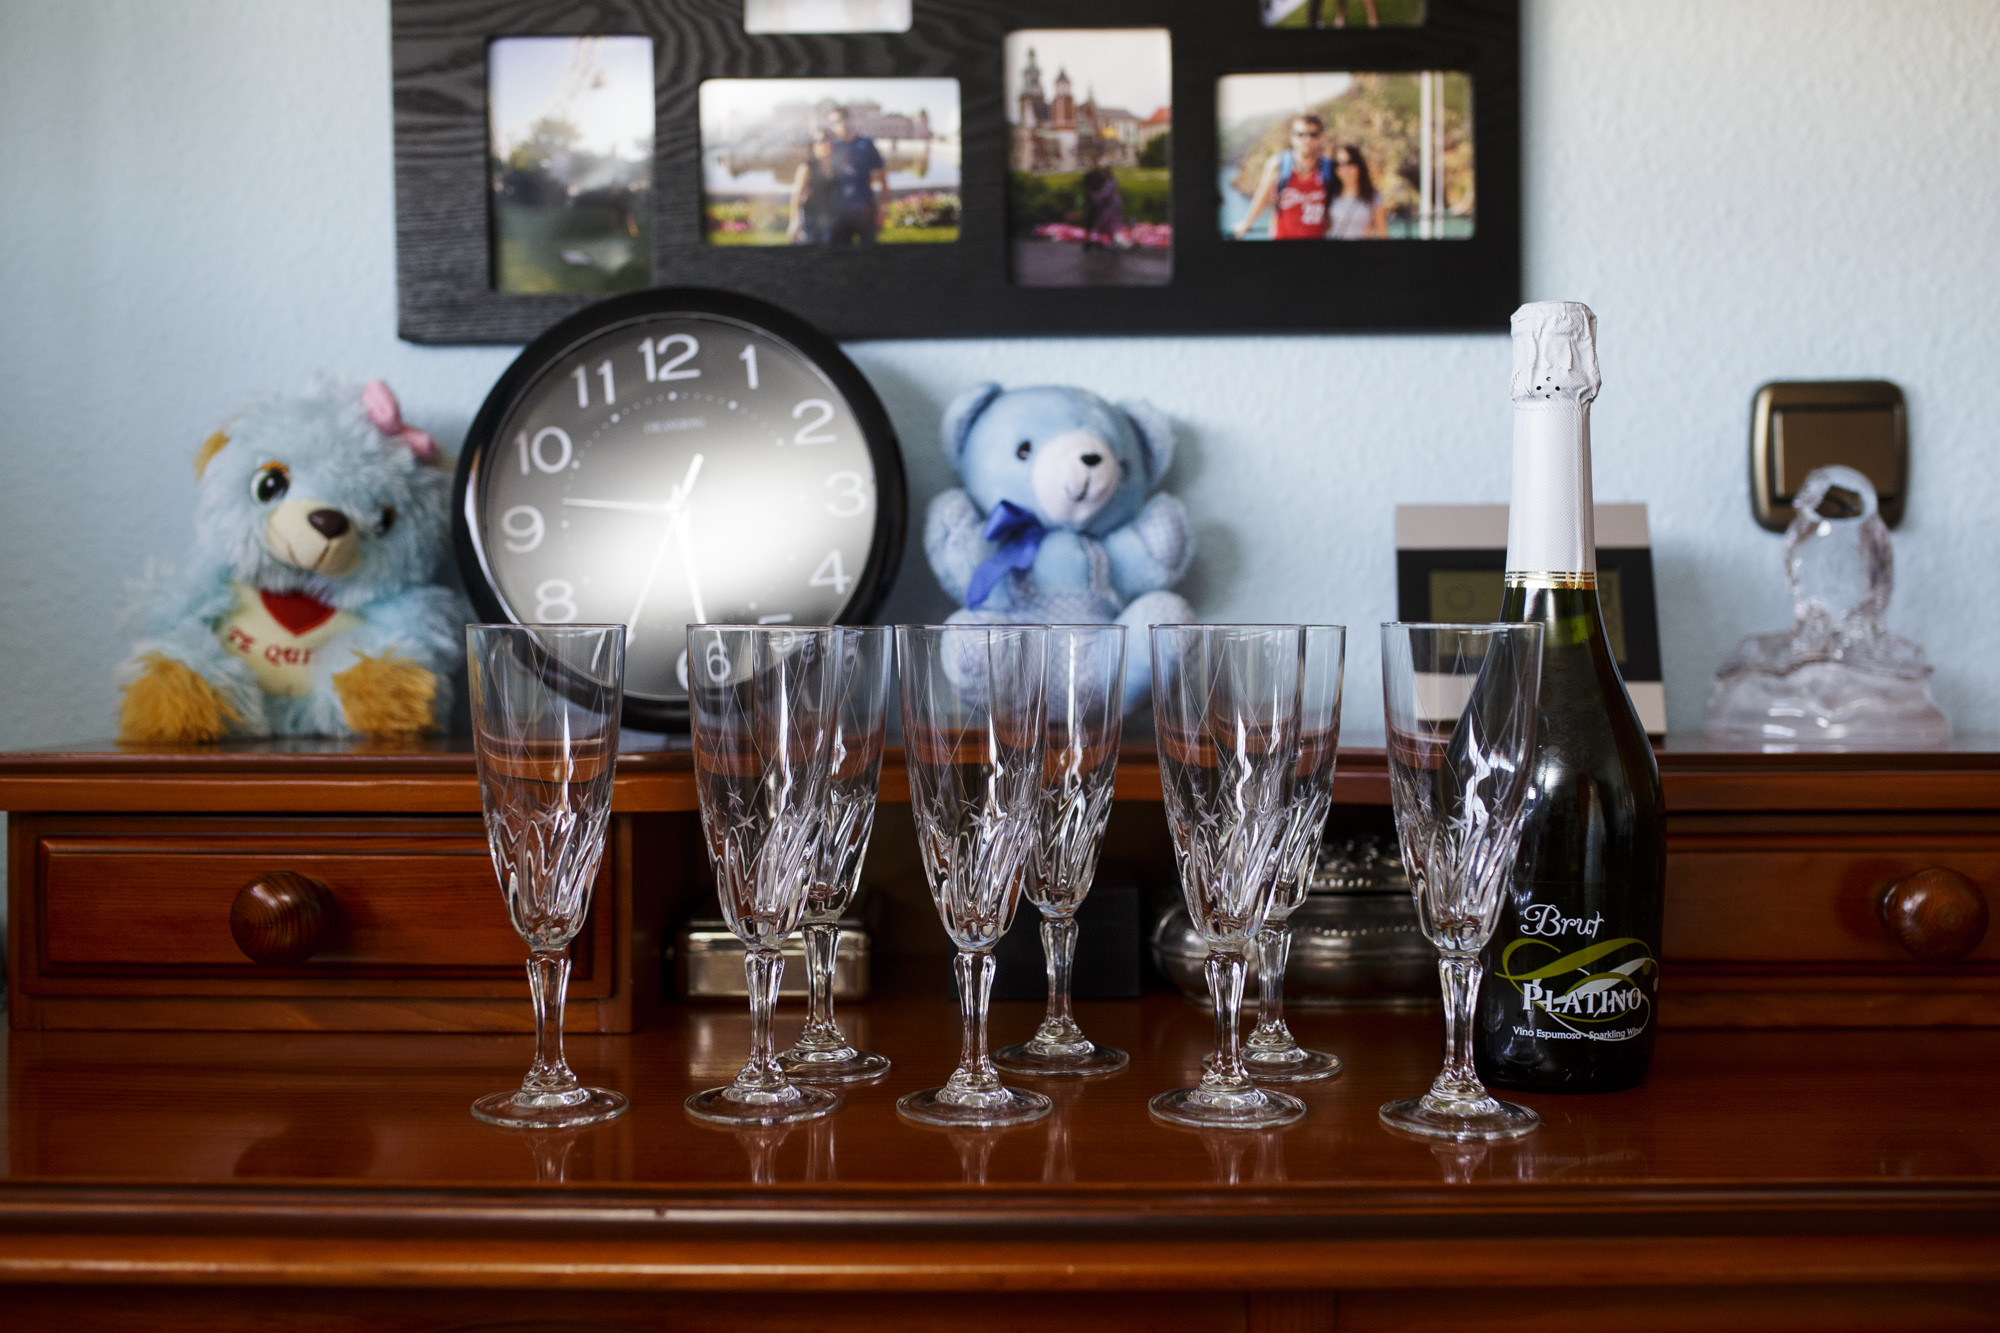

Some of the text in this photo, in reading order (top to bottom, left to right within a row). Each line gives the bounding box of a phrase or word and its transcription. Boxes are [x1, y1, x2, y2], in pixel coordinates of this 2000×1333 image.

[638, 333, 702, 383] 12
[738, 344, 760, 390] 1
[571, 359, 616, 409] 11
[791, 399, 838, 446] 2
[513, 425, 574, 476] 10
[825, 470, 868, 518] 3
[503, 505, 545, 553] 9
[808, 549, 852, 595] 4
[535, 579, 578, 624] 8
[1519, 903, 1605, 939] Brut
[1522, 982, 1642, 1015] PLATINO
[1512, 1026, 1535, 1037] Vino
[1536, 1028, 1582, 1040] Espumoso
[1588, 1029, 1626, 1041] Sparkling
